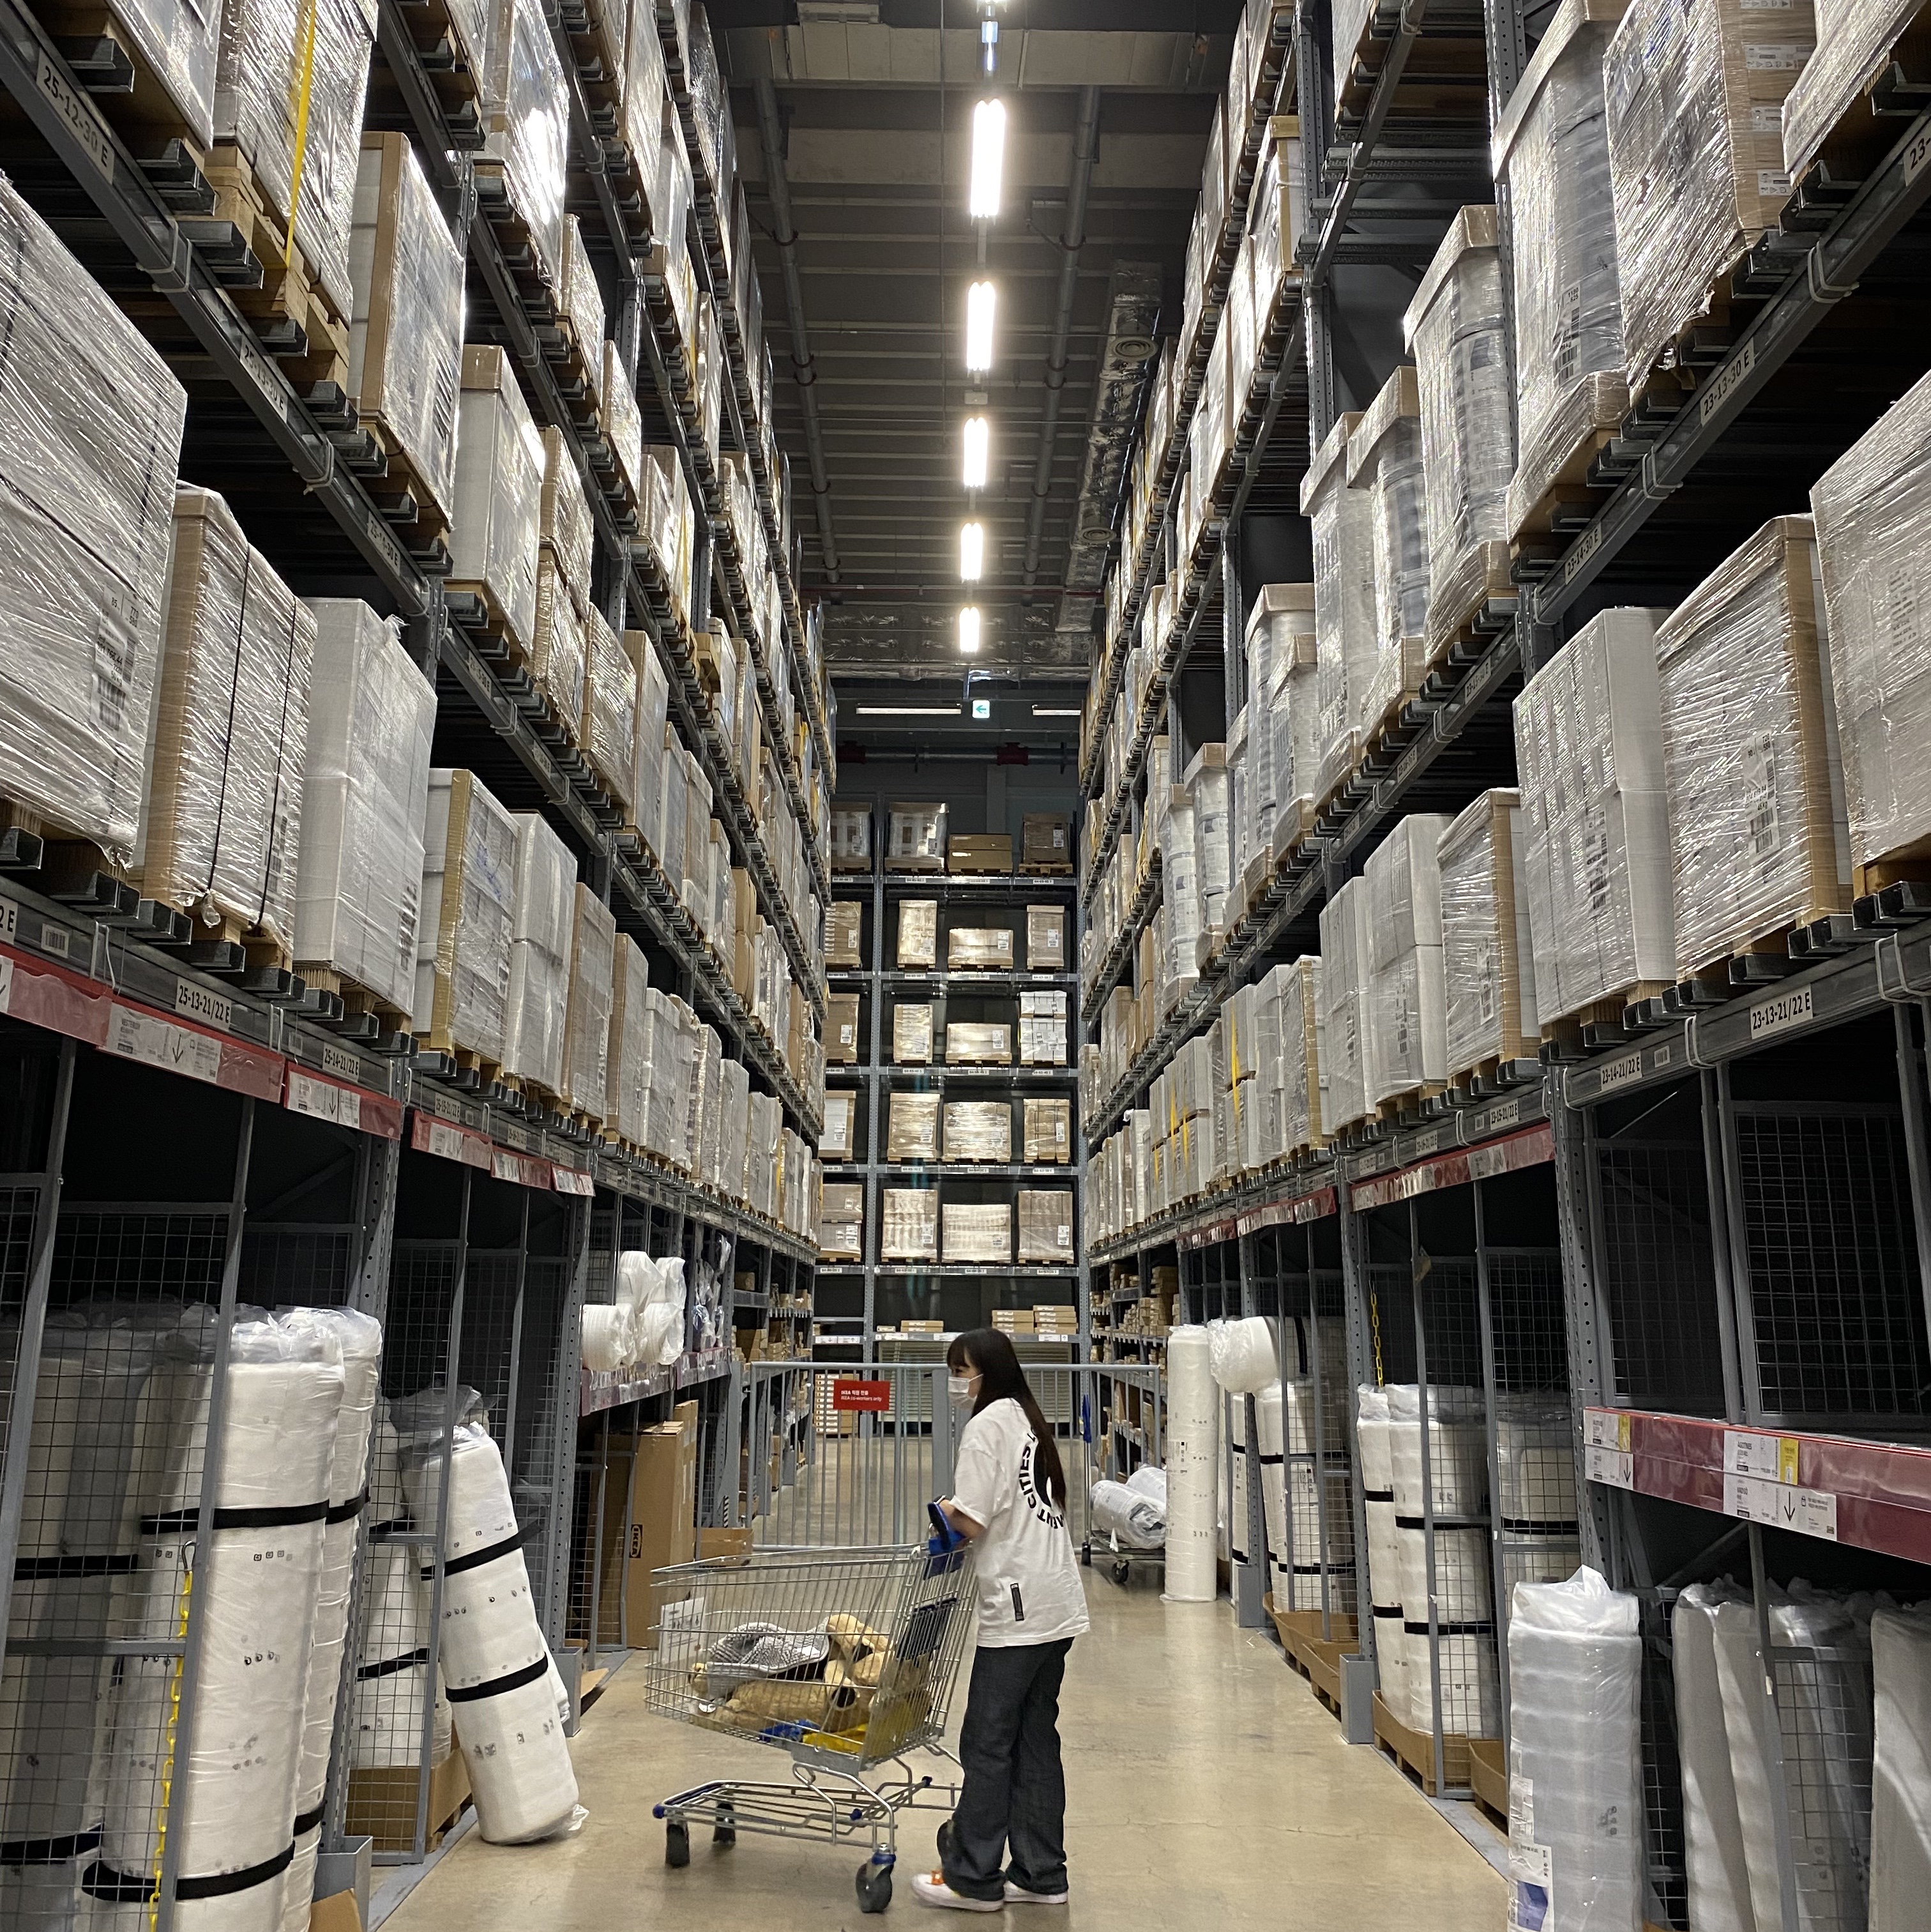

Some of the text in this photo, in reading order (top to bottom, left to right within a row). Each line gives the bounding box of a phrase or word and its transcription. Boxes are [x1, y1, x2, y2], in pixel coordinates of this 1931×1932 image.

[101, 144, 108, 167] E
[1704, 349, 1749, 416] 23-13-30 E
[8, 909, 15, 932] E
[178, 985, 230, 1024] 25-13-21/22 E
[1752, 992, 1811, 1030] 23-13-21/22 E
[324, 1048, 359, 1076] 25-14-21/22 E
[1602, 1056, 1640, 1084] 23-14-21/22 E
[630, 1526, 640, 1556] IKEA
